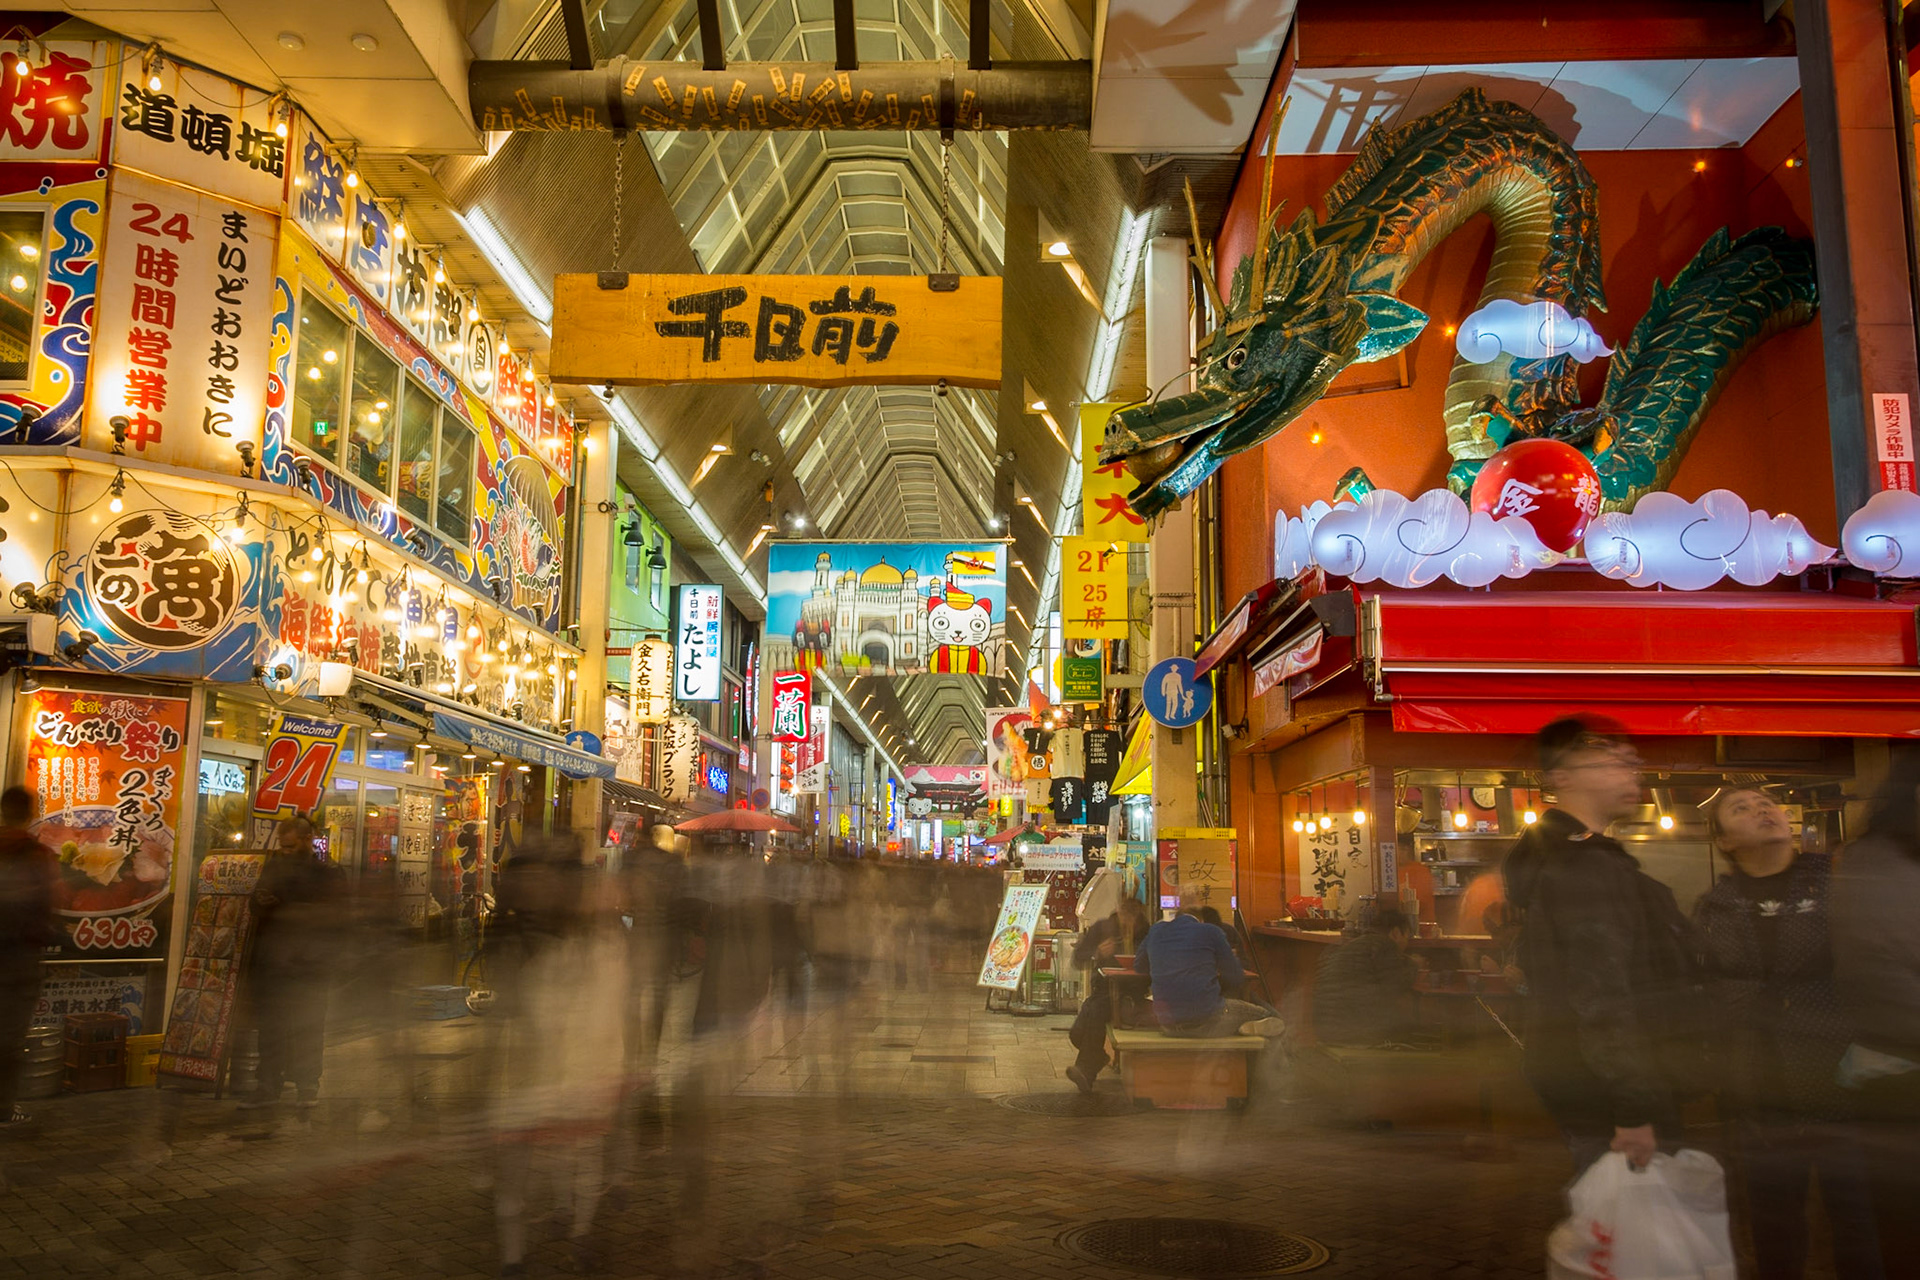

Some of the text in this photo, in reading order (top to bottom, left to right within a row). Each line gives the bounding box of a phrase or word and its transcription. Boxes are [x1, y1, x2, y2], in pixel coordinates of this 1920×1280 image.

[0, 51, 92, 150] 焼
[120, 82, 285, 179] 道頓堀
[122, 203, 195, 452] 24時間営業中
[202, 210, 249, 439] まいどおおきに
[654, 285, 900, 364] 千日前
[1882, 398, 1904, 459] 防犯カメラ作動中
[286, 525, 382, 613] とれたて
[1077, 550, 1110, 573] 2F
[1083, 585, 1107, 602] 25
[690, 588, 699, 620] 千日前
[1085, 606, 1106, 631] 席
[636, 643, 653, 717] 金久右衛門
[683, 623, 704, 696] たよし
[36, 712, 179, 762] どんぶり祭り
[284, 721, 337, 737] Welcome!
[773, 673, 806, 738] 一蘭
[254, 738, 337, 817] 24
[662, 720, 678, 799] 大阪ブラック
[147, 767, 172, 831] まぐろ
[75, 919, 157, 949] 630円
